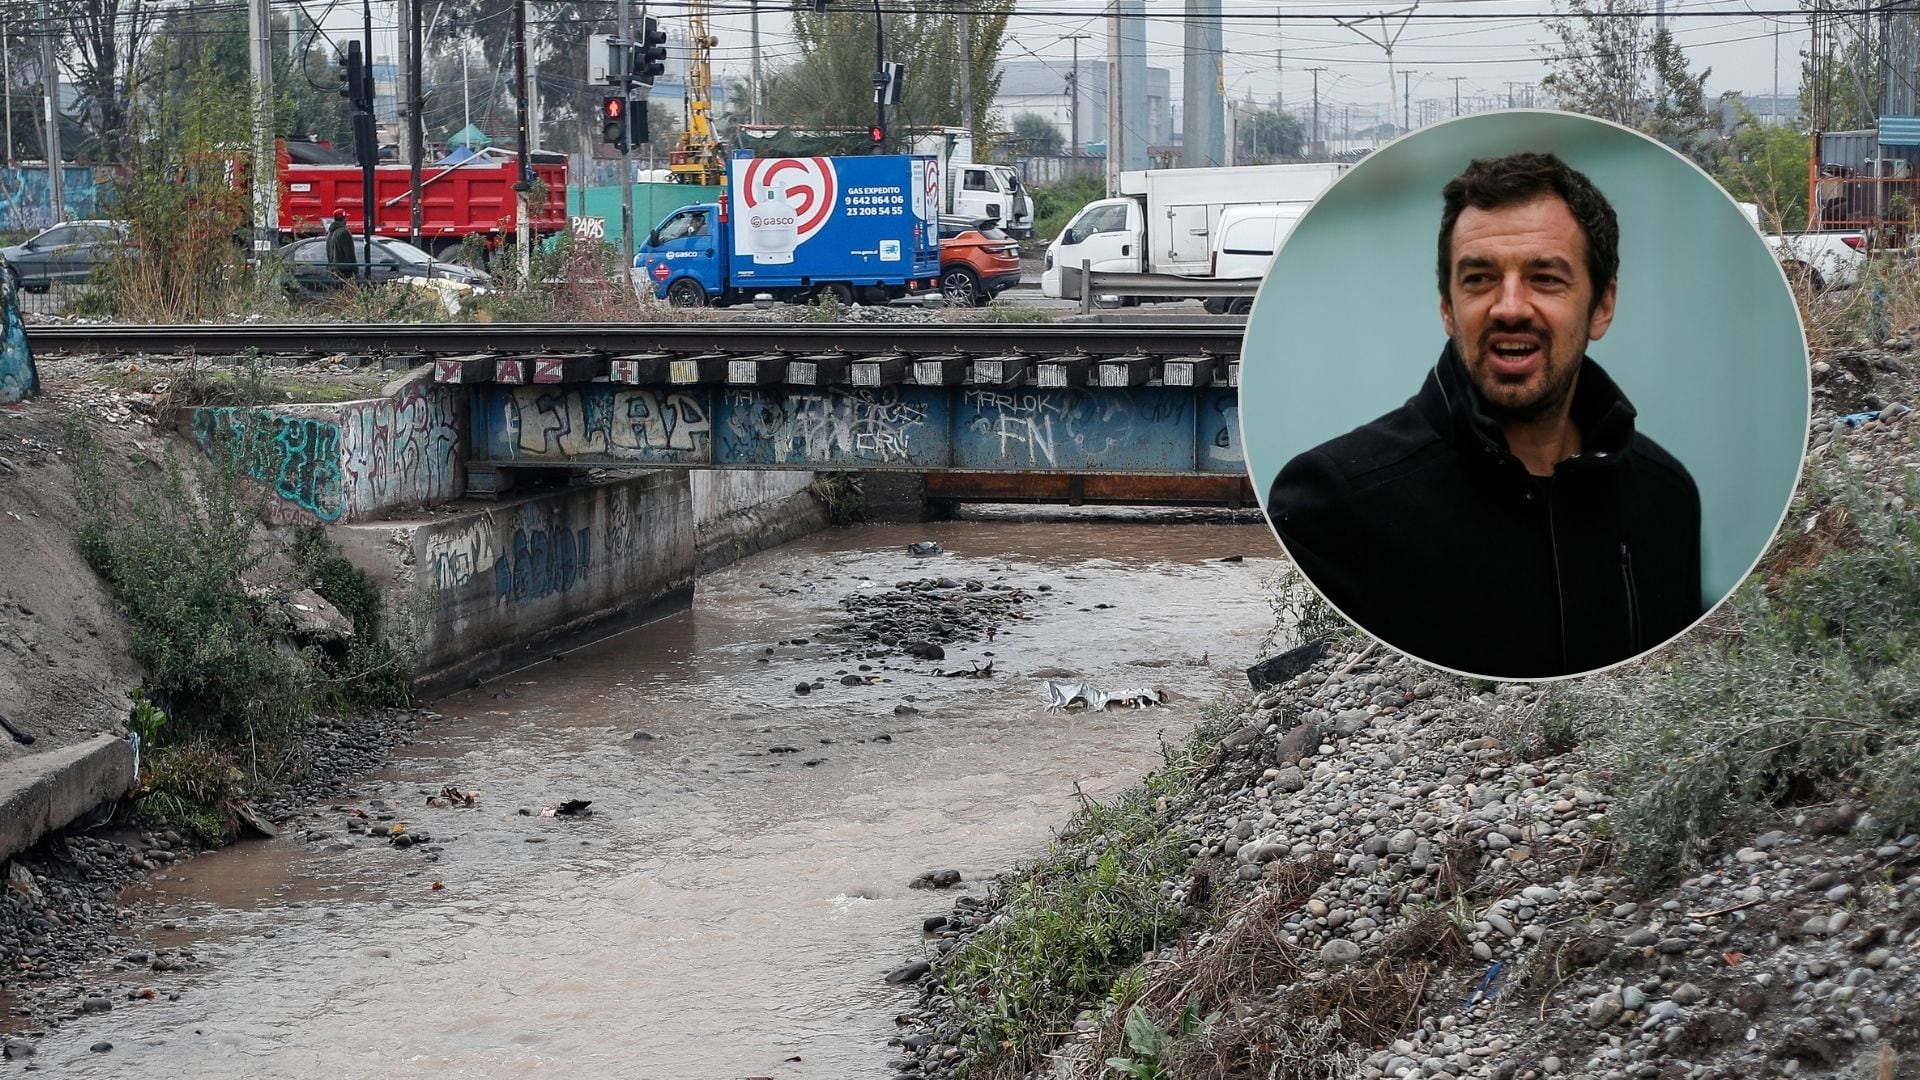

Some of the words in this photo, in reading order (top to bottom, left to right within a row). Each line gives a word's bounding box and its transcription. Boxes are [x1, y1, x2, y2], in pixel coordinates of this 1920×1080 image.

[848, 187, 863, 195] GAS
[864, 186, 900, 194] EXPEDITO
[845, 197, 851, 205] 9
[853, 196, 870, 205] 642
[872, 196, 889, 204] 864
[891, 195, 904, 204] 06
[846, 208, 858, 216] 23
[859, 207, 877, 216] 208
[878, 207, 890, 215] 54
[891, 206, 903, 215] 55
[571, 216, 605, 239] PAPAS
[964, 389, 1060, 414] MARLOK
